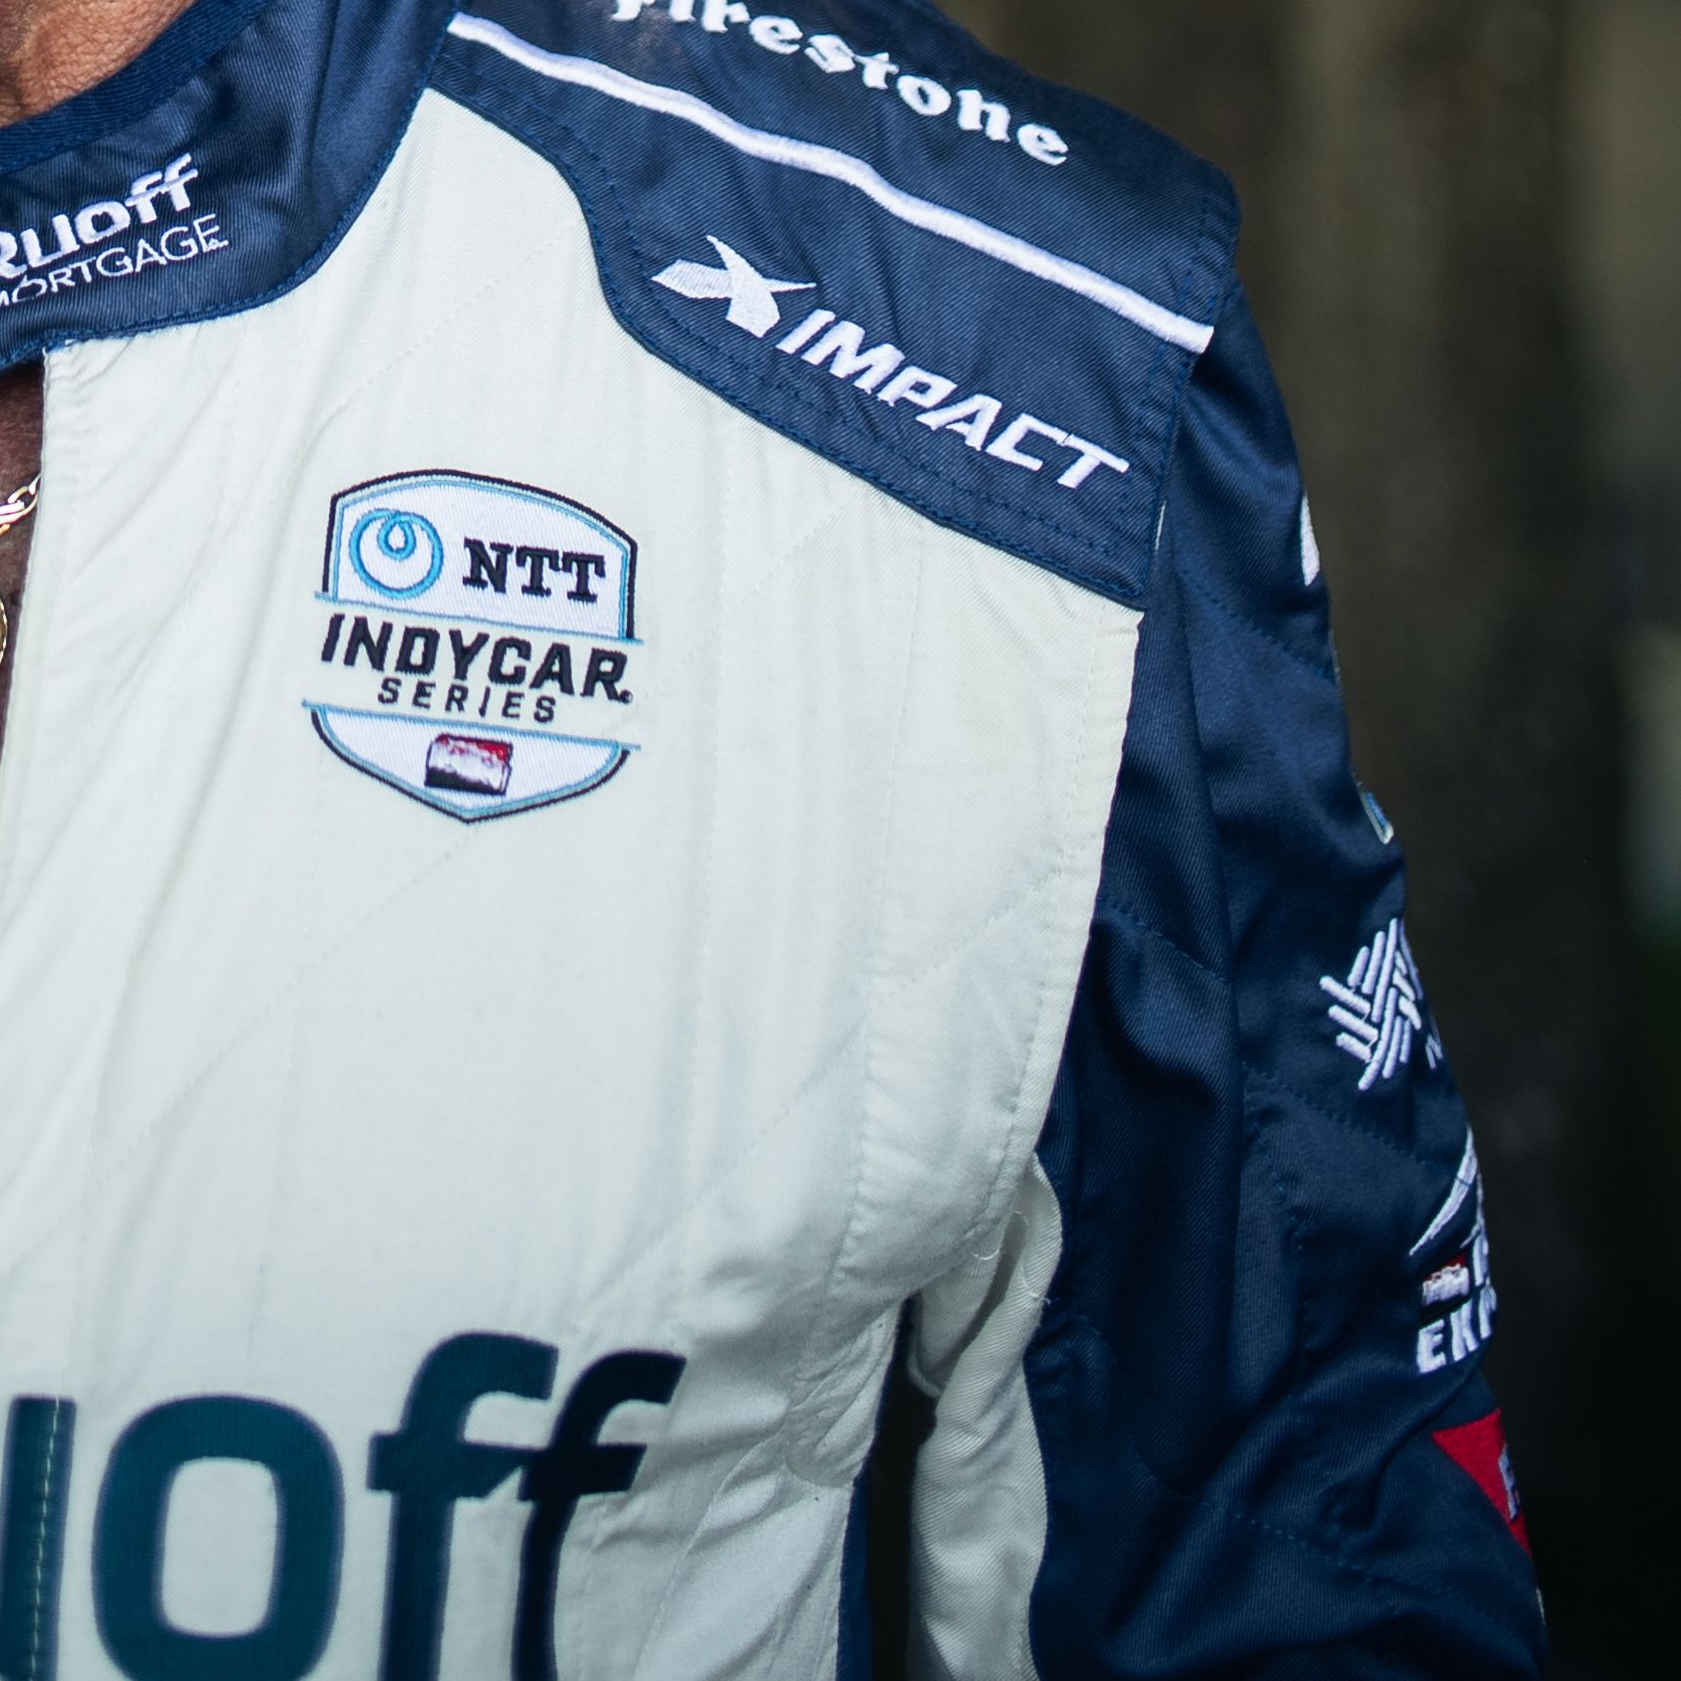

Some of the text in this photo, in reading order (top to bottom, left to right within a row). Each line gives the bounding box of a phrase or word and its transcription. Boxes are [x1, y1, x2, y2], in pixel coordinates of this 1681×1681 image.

[775, 309, 1129, 489] IMPACT
[463, 538, 606, 603] NTT
[321, 613, 630, 704] INDYCAR
[378, 677, 557, 723] SERIES
